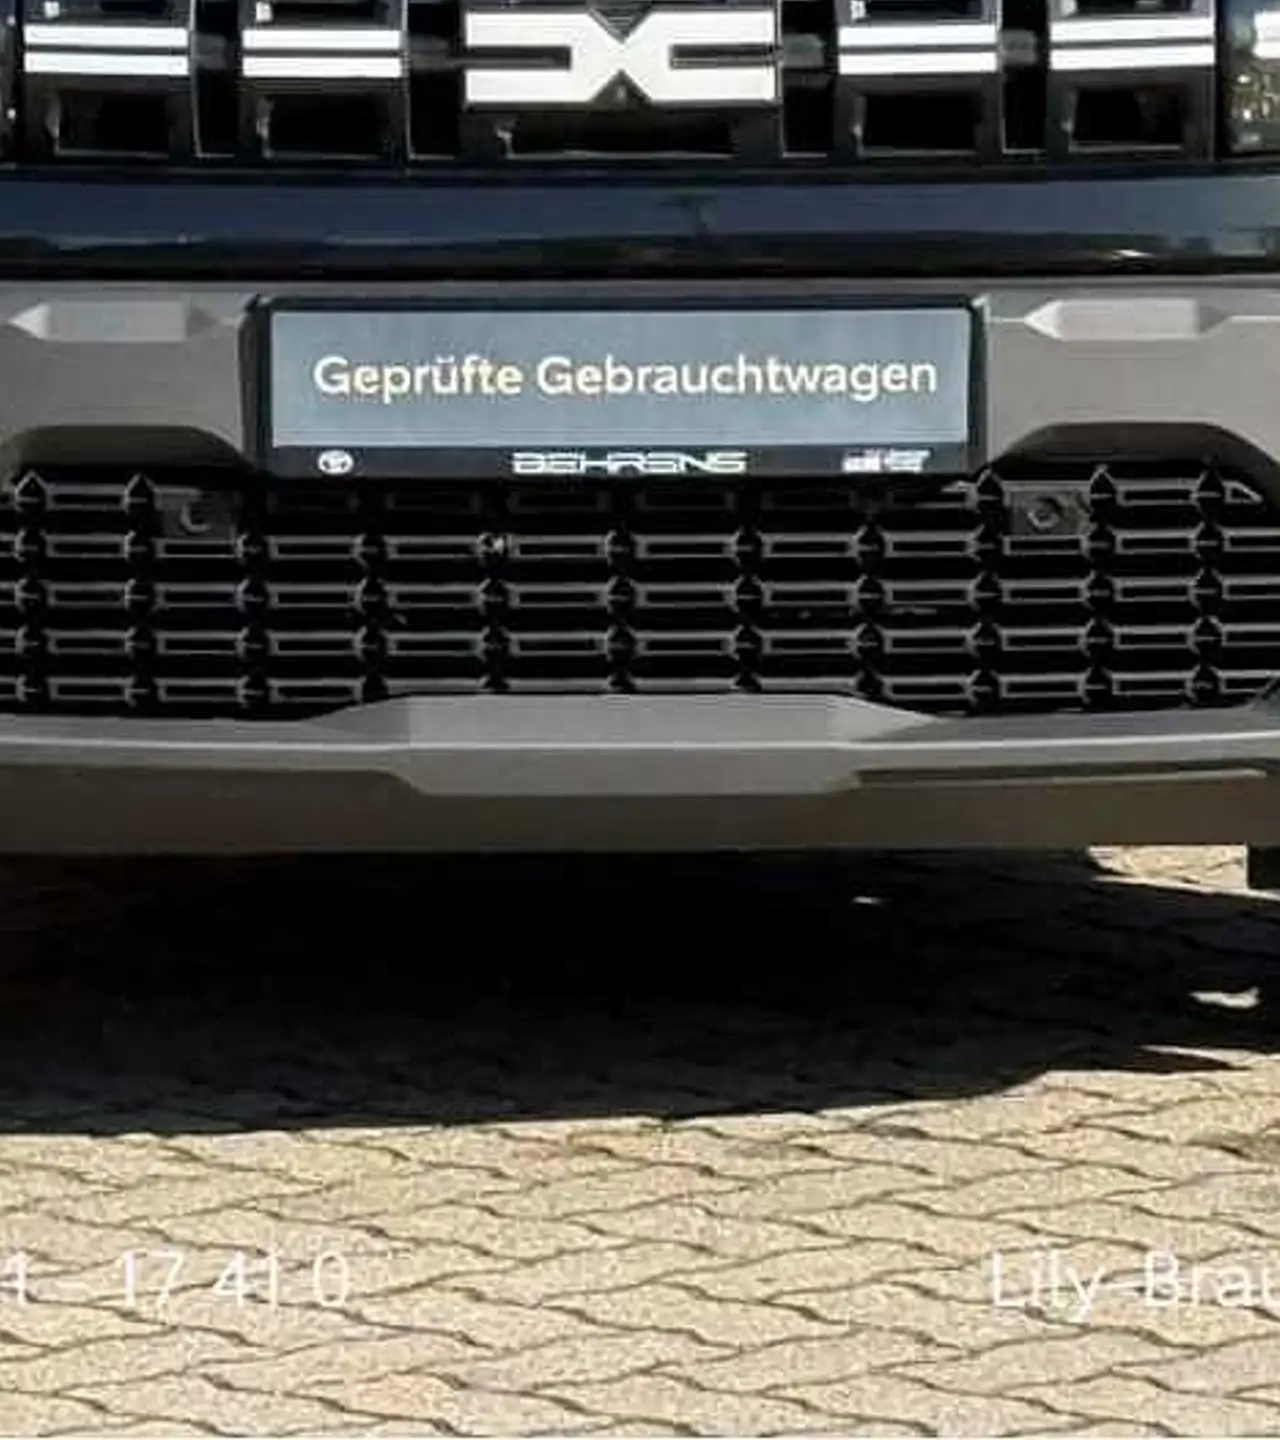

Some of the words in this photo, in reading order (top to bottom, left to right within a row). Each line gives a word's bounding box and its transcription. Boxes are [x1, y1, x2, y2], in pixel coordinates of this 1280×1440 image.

[313, 354, 523, 404] Geprüfte
[535, 354, 939, 403] Gebrauchtwagen
[511, 452, 747, 475] BEHRENS
